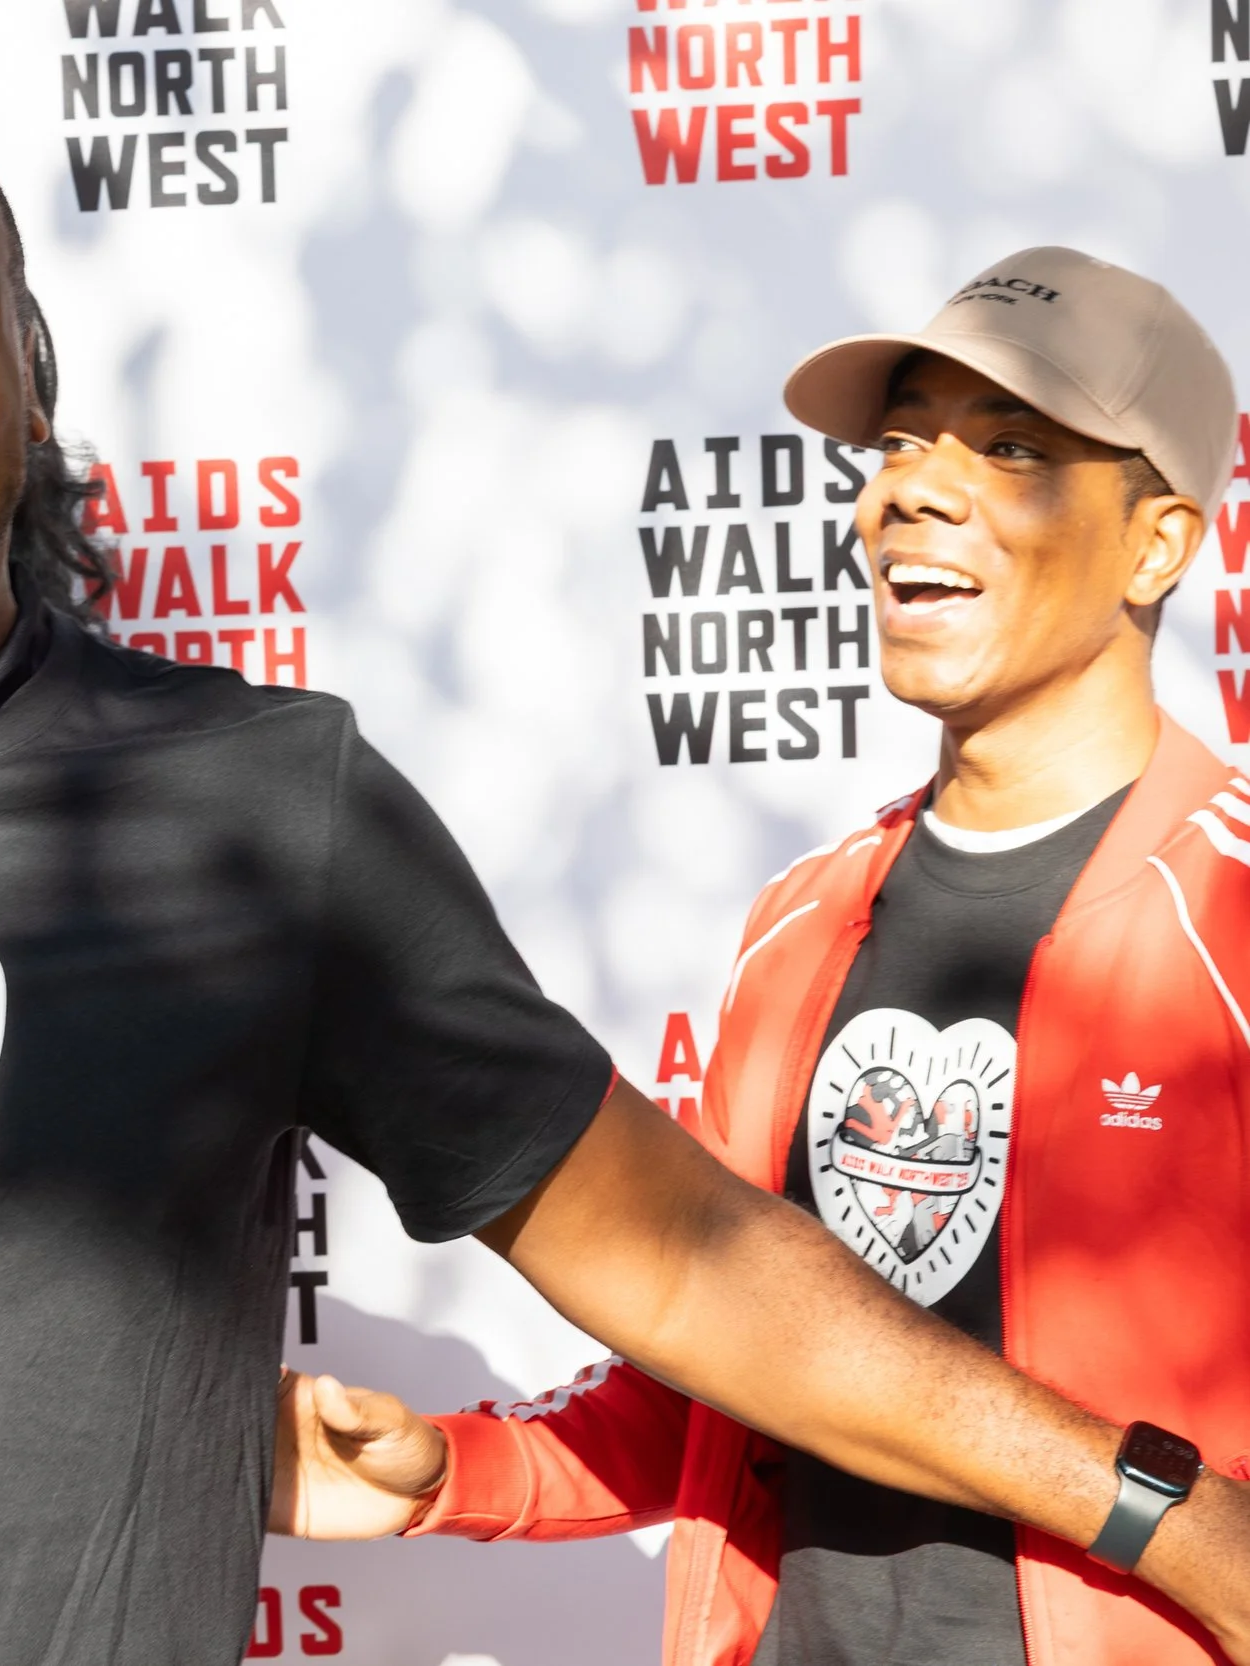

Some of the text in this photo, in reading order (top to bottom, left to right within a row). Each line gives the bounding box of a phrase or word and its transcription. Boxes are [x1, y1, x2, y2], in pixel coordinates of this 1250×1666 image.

[61, 45, 289, 120] NORTH
[628, 14, 862, 93] NORTH
[64, 127, 289, 213] WEST
[631, 97, 862, 186] WEST
[958, 277, 1062, 304] OACH
[81, 456, 302, 535] AIDS
[640, 433, 868, 512] AIDS
[78, 541, 307, 621] WALK
[637, 519, 872, 598] WALK
[642, 604, 871, 677] NORTH
[645, 684, 871, 767] WEST
[1099, 1111, 1163, 1131] adidas
[244, 1584, 343, 1659] DS
